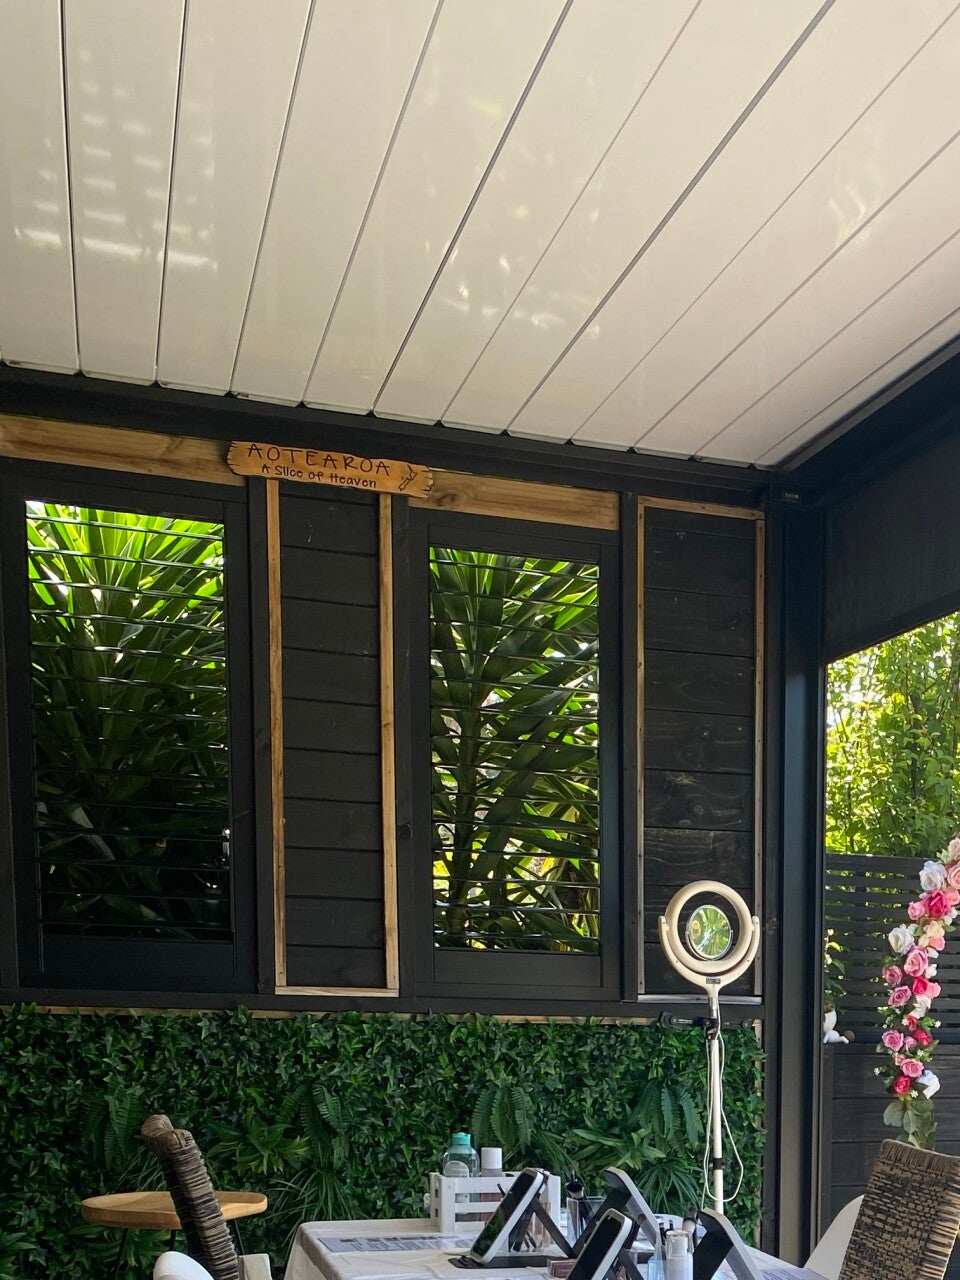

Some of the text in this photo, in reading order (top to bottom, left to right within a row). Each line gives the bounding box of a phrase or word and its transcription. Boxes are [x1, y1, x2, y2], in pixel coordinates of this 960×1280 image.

[247, 443, 390, 476] AOTEAROA
[261, 463, 376, 488] A Slice of Heaven
